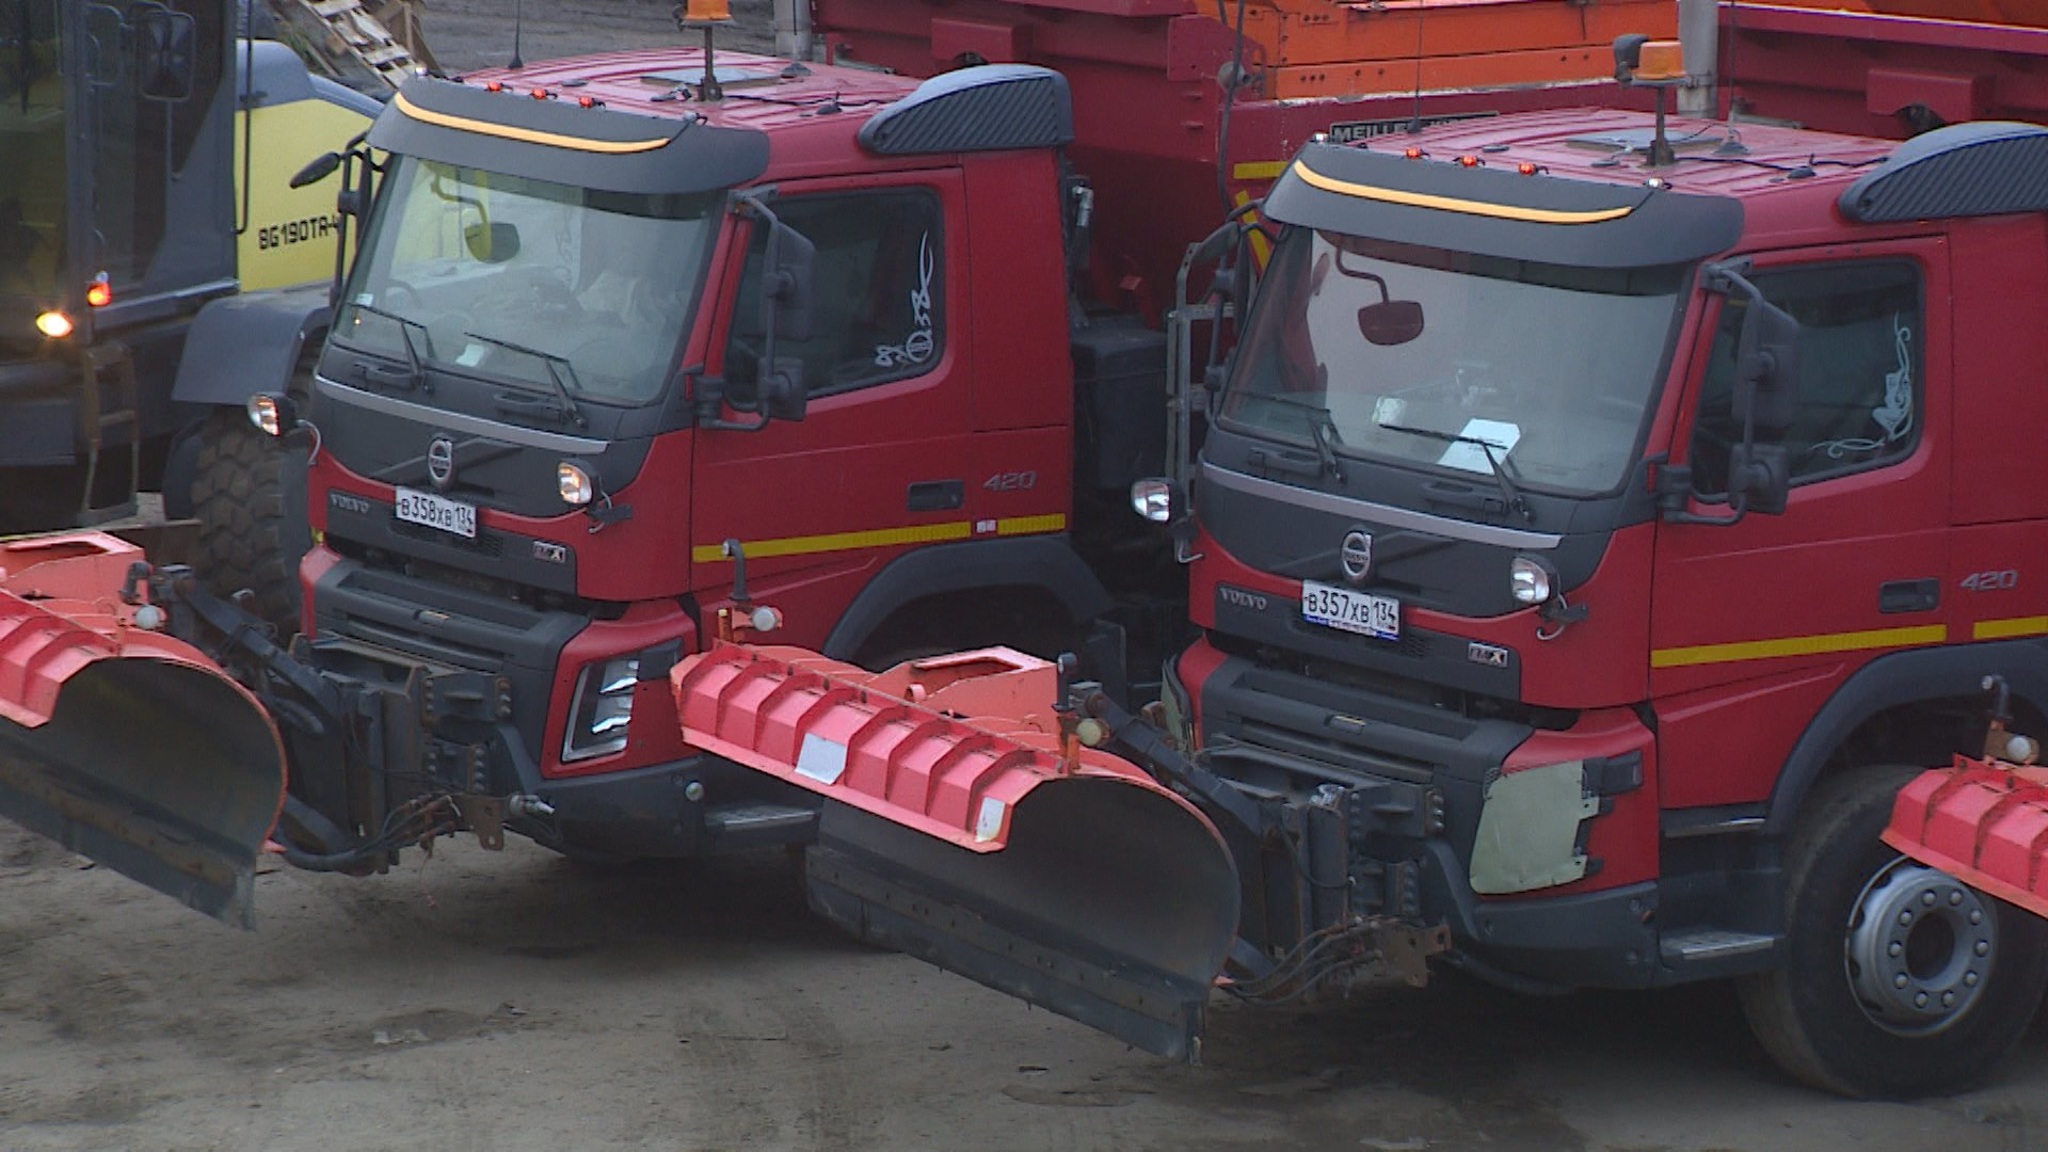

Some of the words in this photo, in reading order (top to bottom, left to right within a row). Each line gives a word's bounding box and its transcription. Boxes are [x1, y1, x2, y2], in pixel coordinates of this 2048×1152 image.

[983, 470, 1037, 491] 420
[1960, 569, 2019, 591] 420
[1219, 587, 1267, 611] VOLVO
